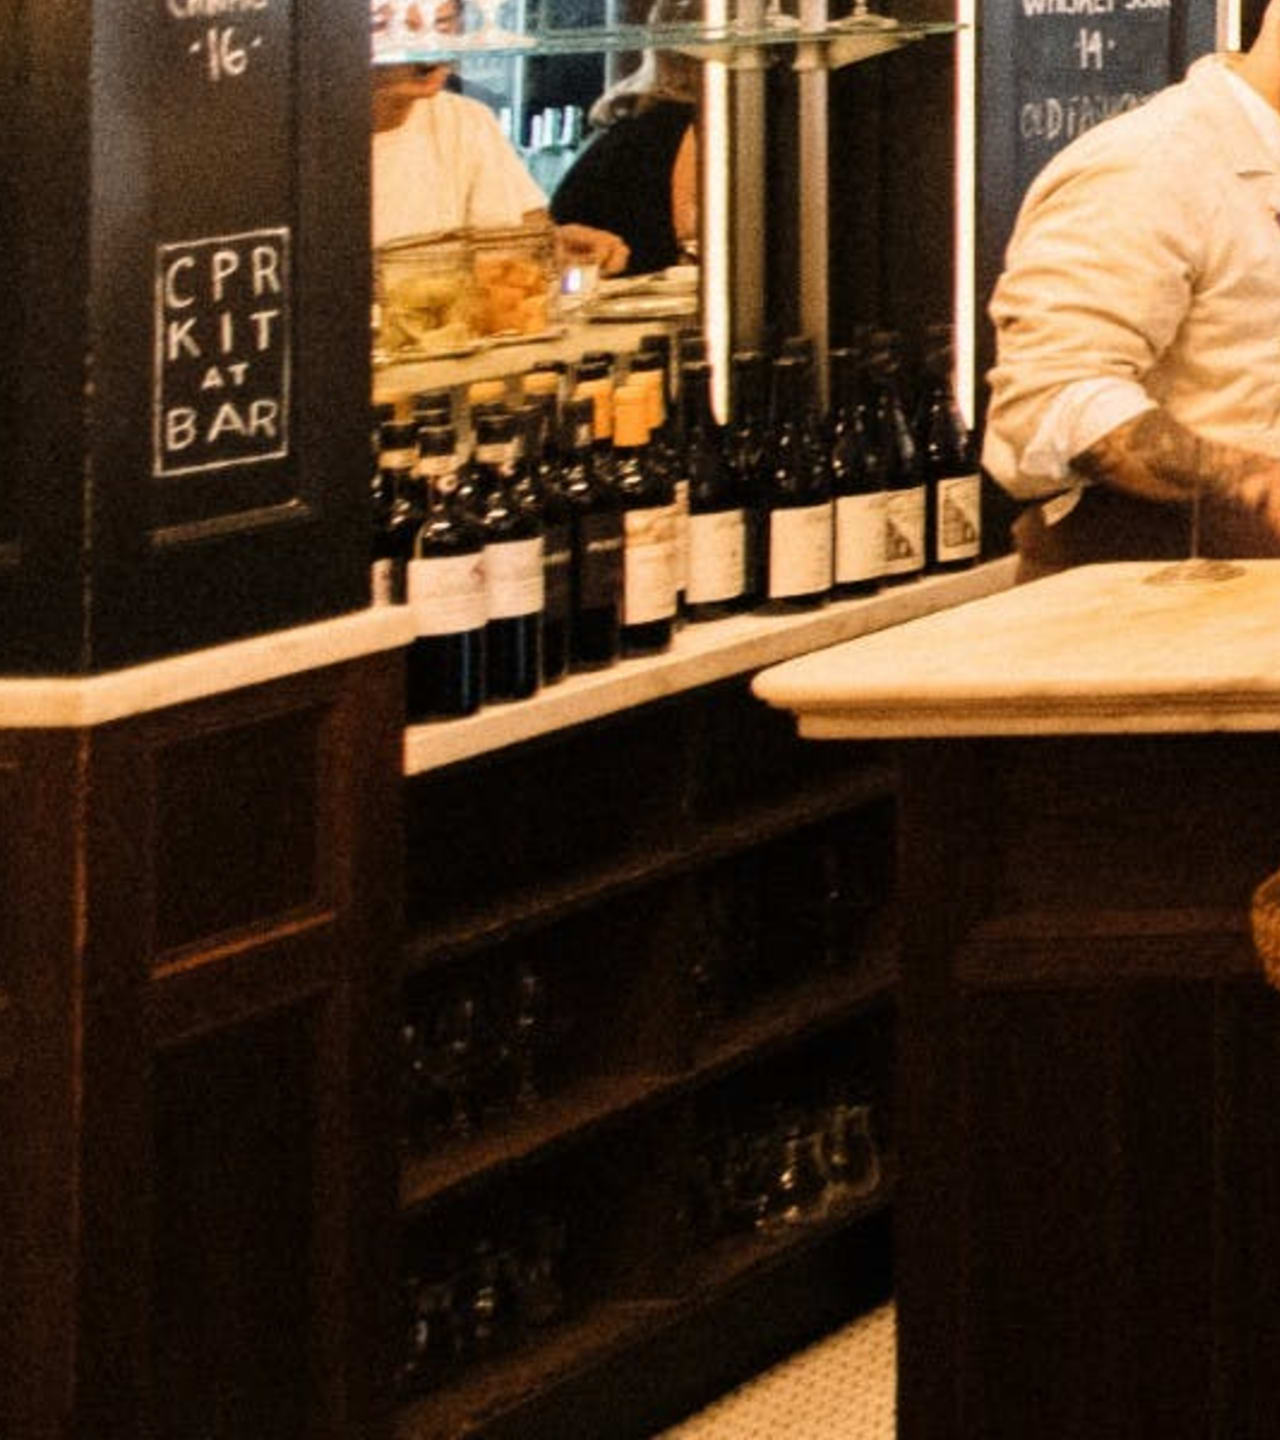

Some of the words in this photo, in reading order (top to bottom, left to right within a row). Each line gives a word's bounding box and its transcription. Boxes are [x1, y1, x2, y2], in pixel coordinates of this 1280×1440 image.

[165, 246, 281, 309] CPR
[167, 310, 280, 362] KIT
[201, 361, 248, 390] AT
[165, 399, 277, 452] BAR
